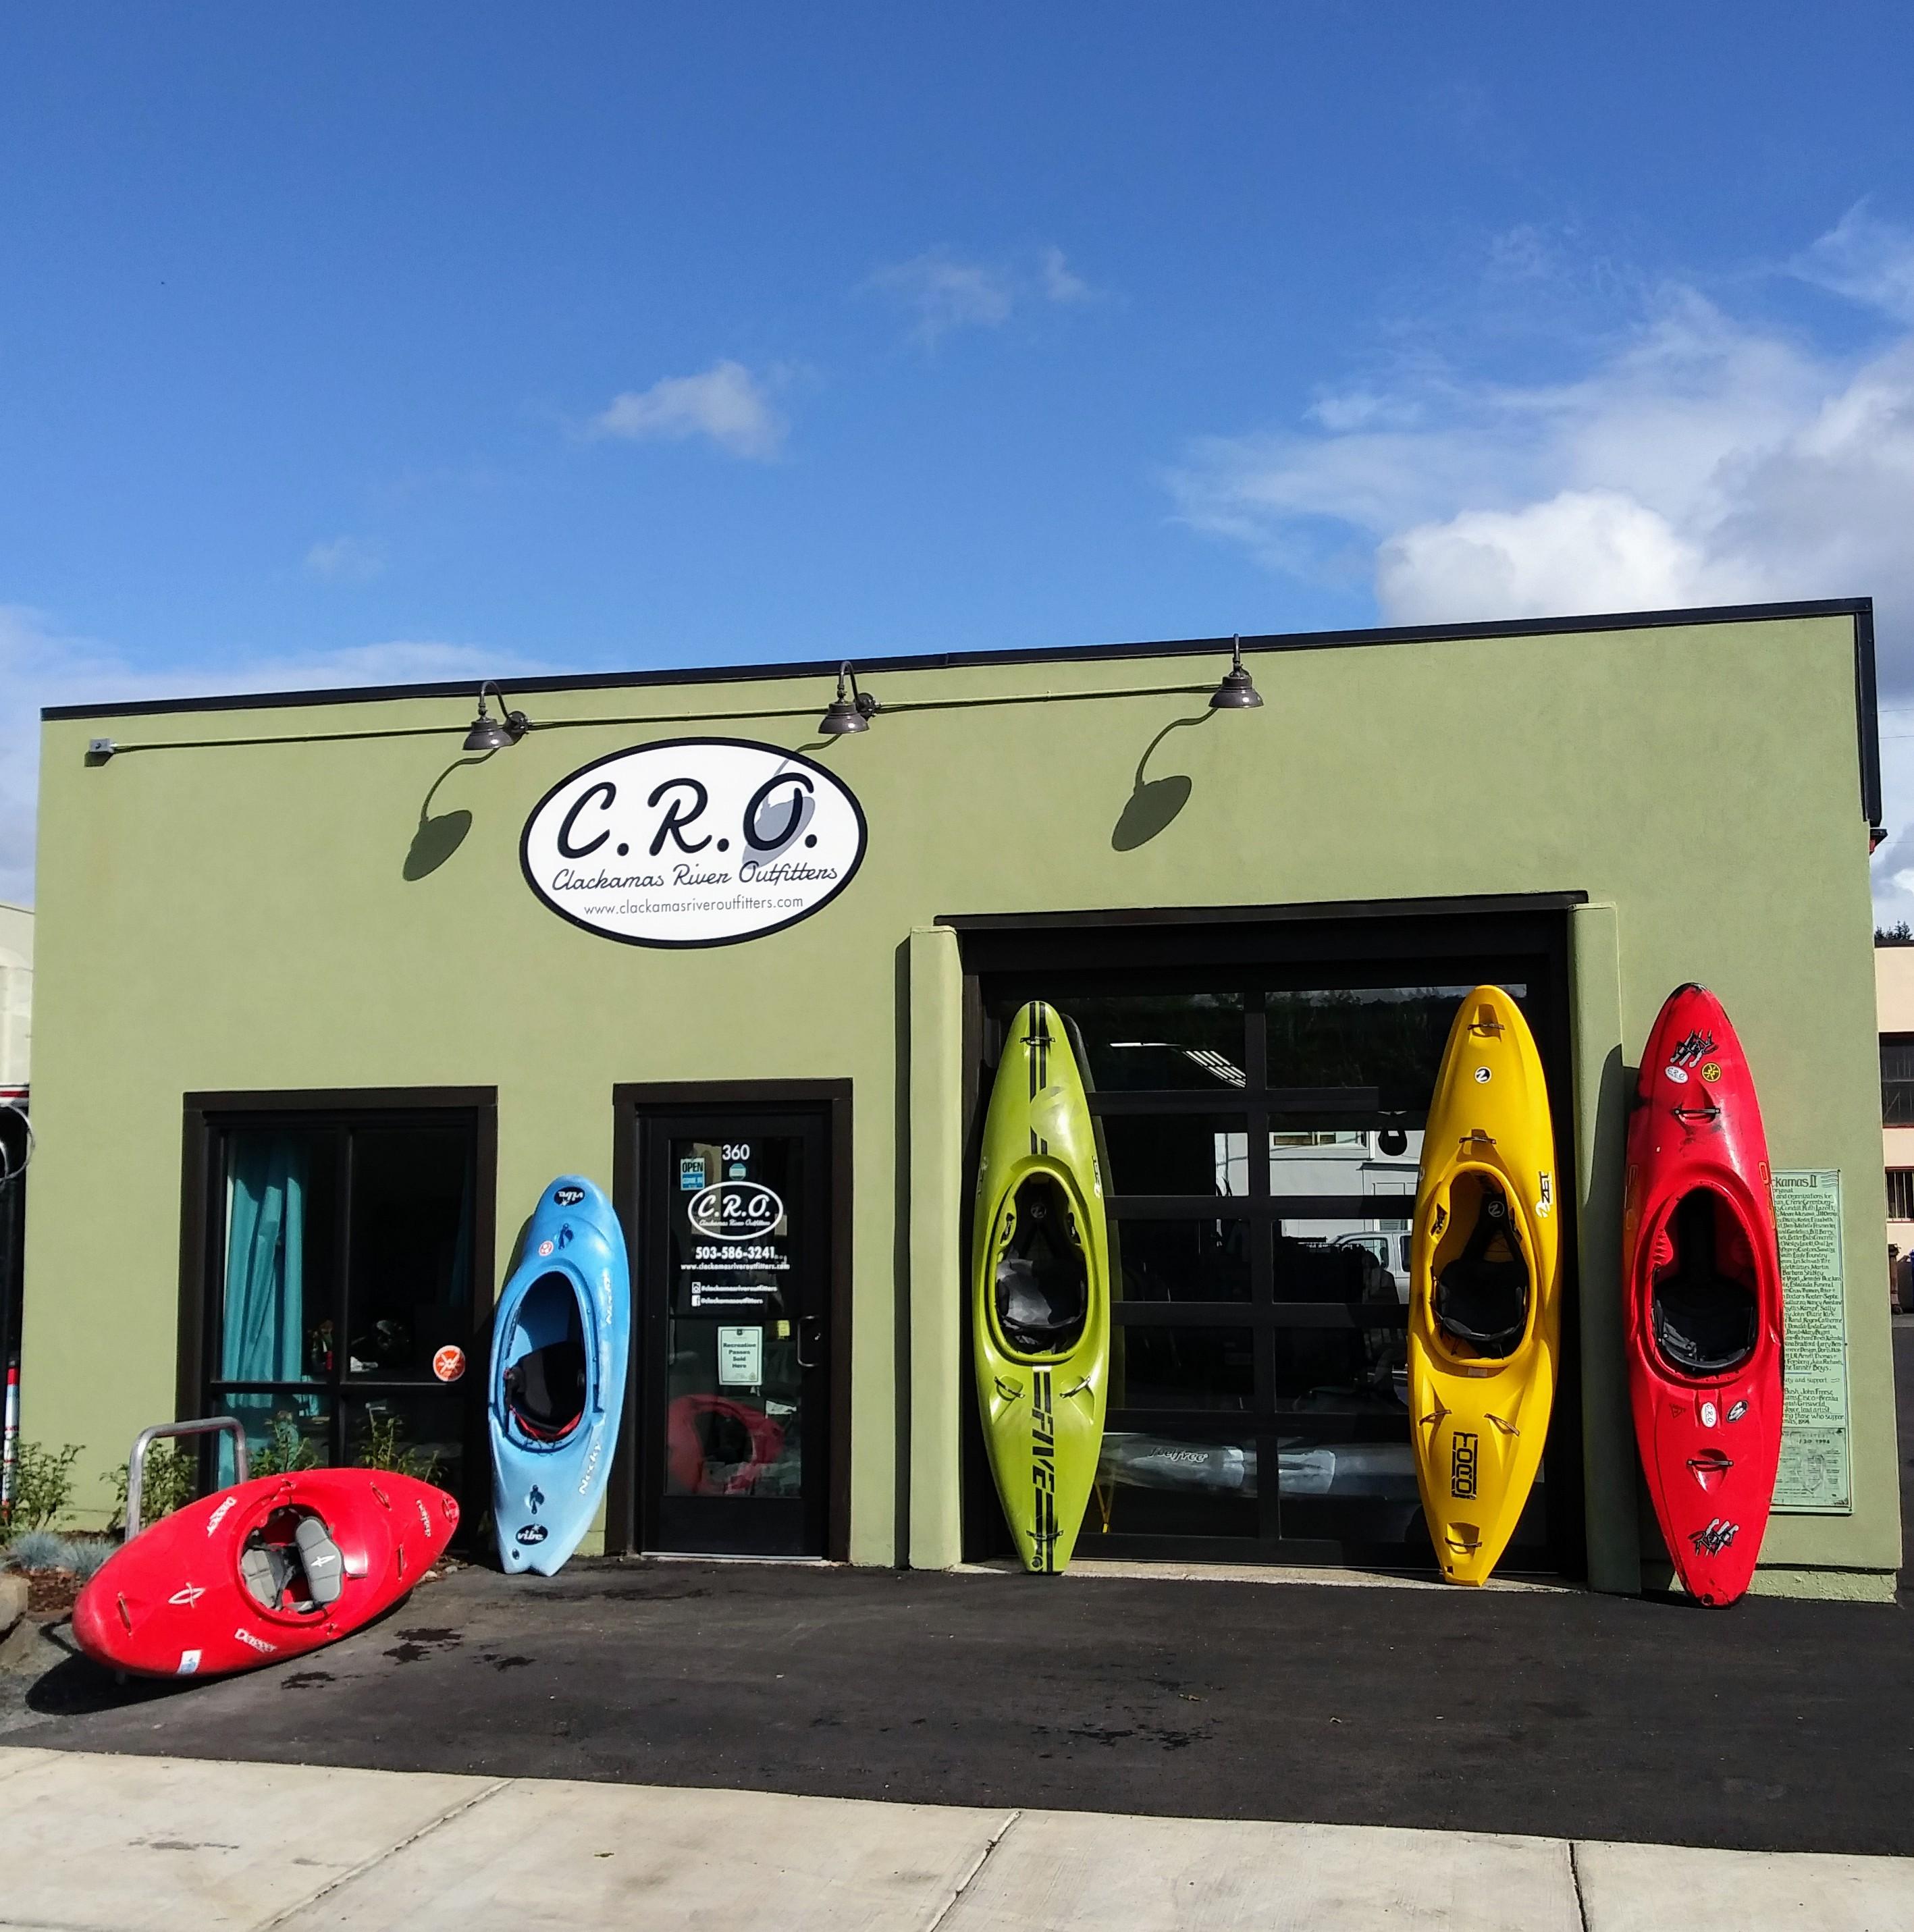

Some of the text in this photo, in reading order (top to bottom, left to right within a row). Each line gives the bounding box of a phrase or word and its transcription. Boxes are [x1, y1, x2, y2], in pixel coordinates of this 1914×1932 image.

[557, 772, 818, 859] C.R.O.
[552, 861, 838, 890] Clackamas River Outfitters
[584, 895, 803, 915] www.clackamasriveroutfitters.com
[722, 1144, 750, 1160] 360
[683, 1162, 703, 1173] OPEN
[698, 1194, 771, 1217] C.R.O.
[695, 1246, 775, 1260] 503-586-3241
[1032, 1407, 1055, 1493] FIVE
[517, 1530, 543, 1540] vibe
